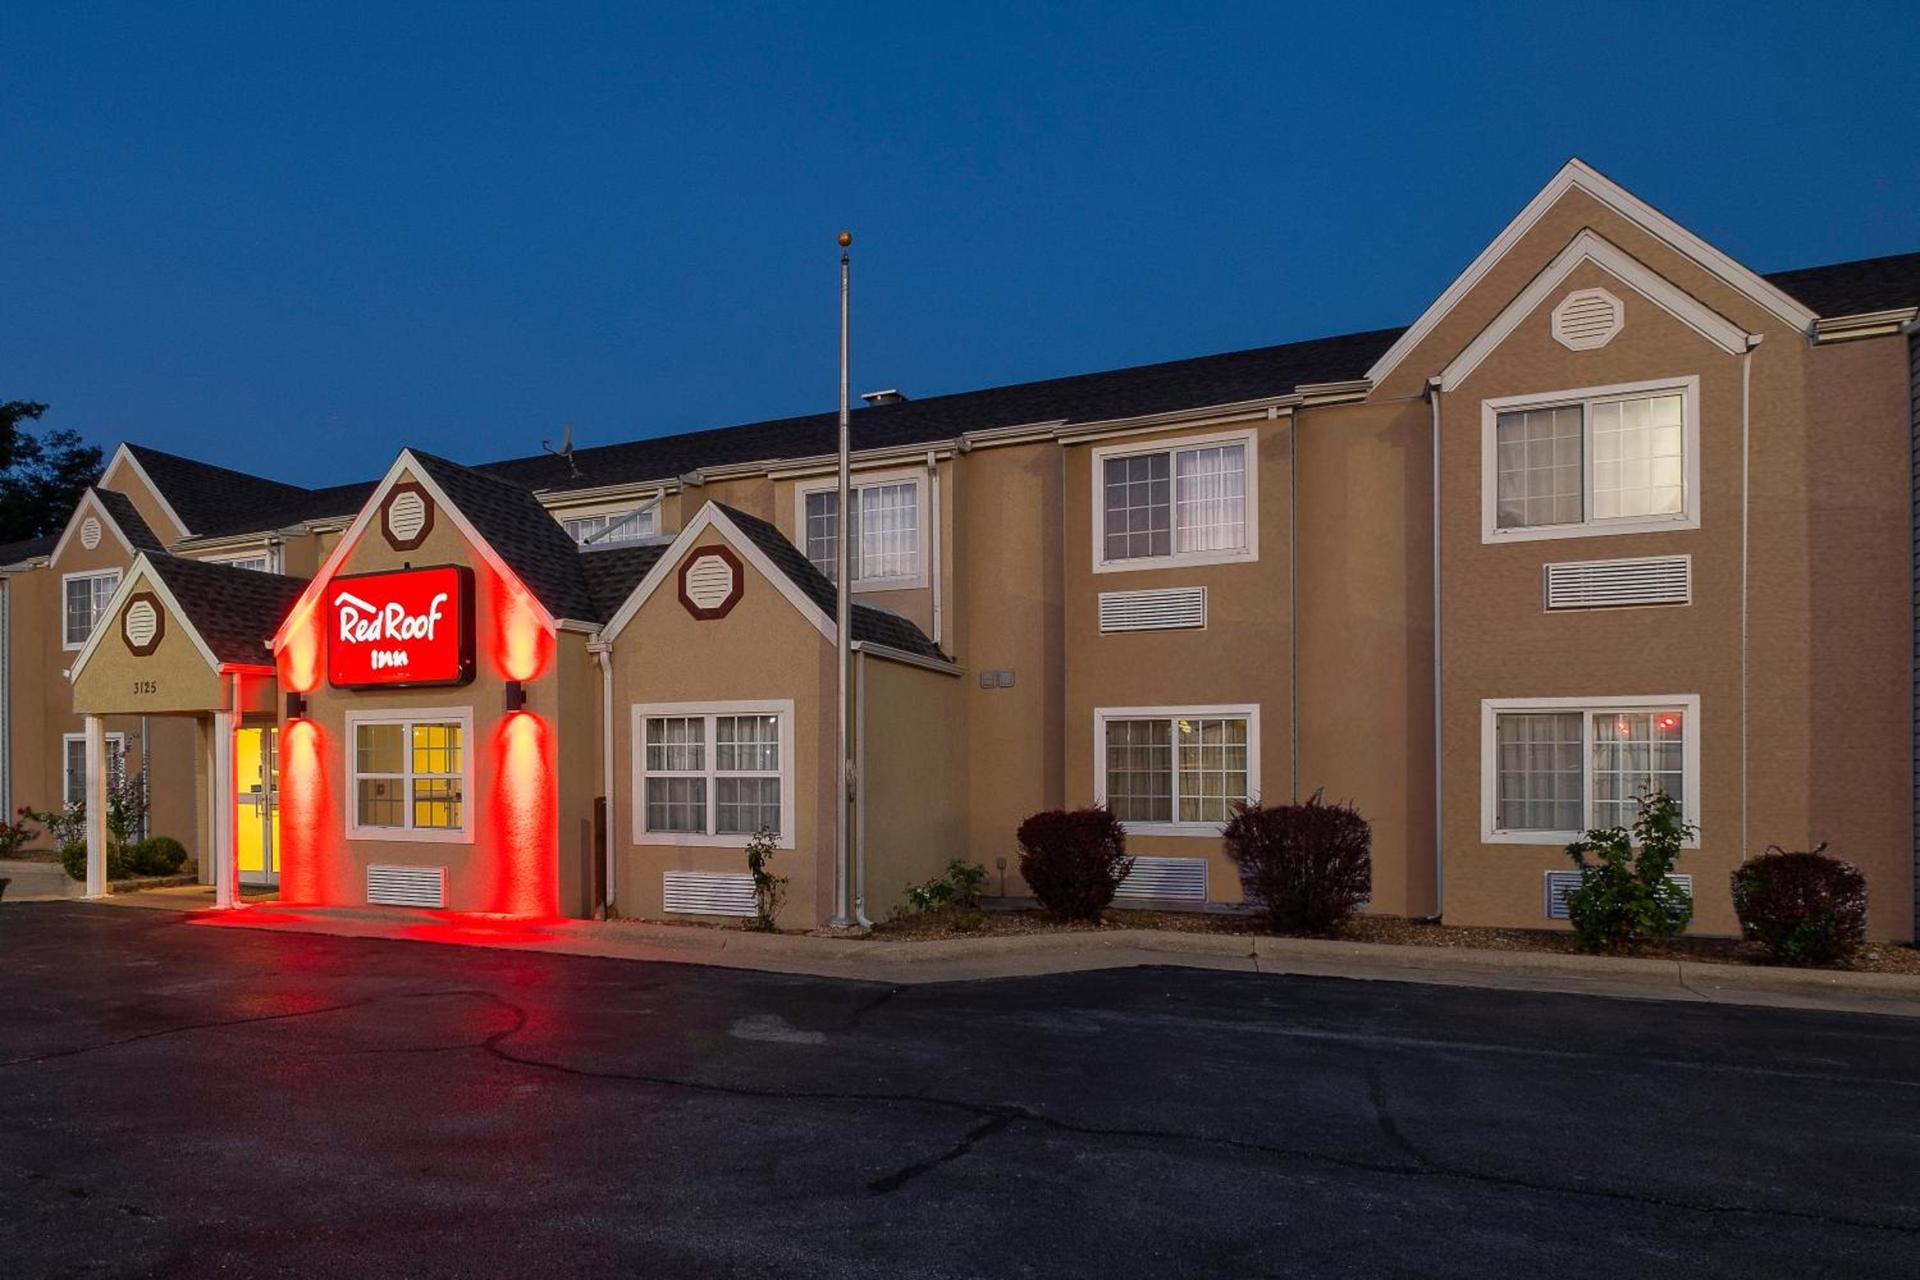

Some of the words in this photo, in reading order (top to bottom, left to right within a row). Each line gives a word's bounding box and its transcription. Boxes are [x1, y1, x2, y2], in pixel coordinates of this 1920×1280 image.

[340, 606, 384, 644] Red
[385, 593, 448, 641] Roof
[133, 680, 157, 695] 3125
